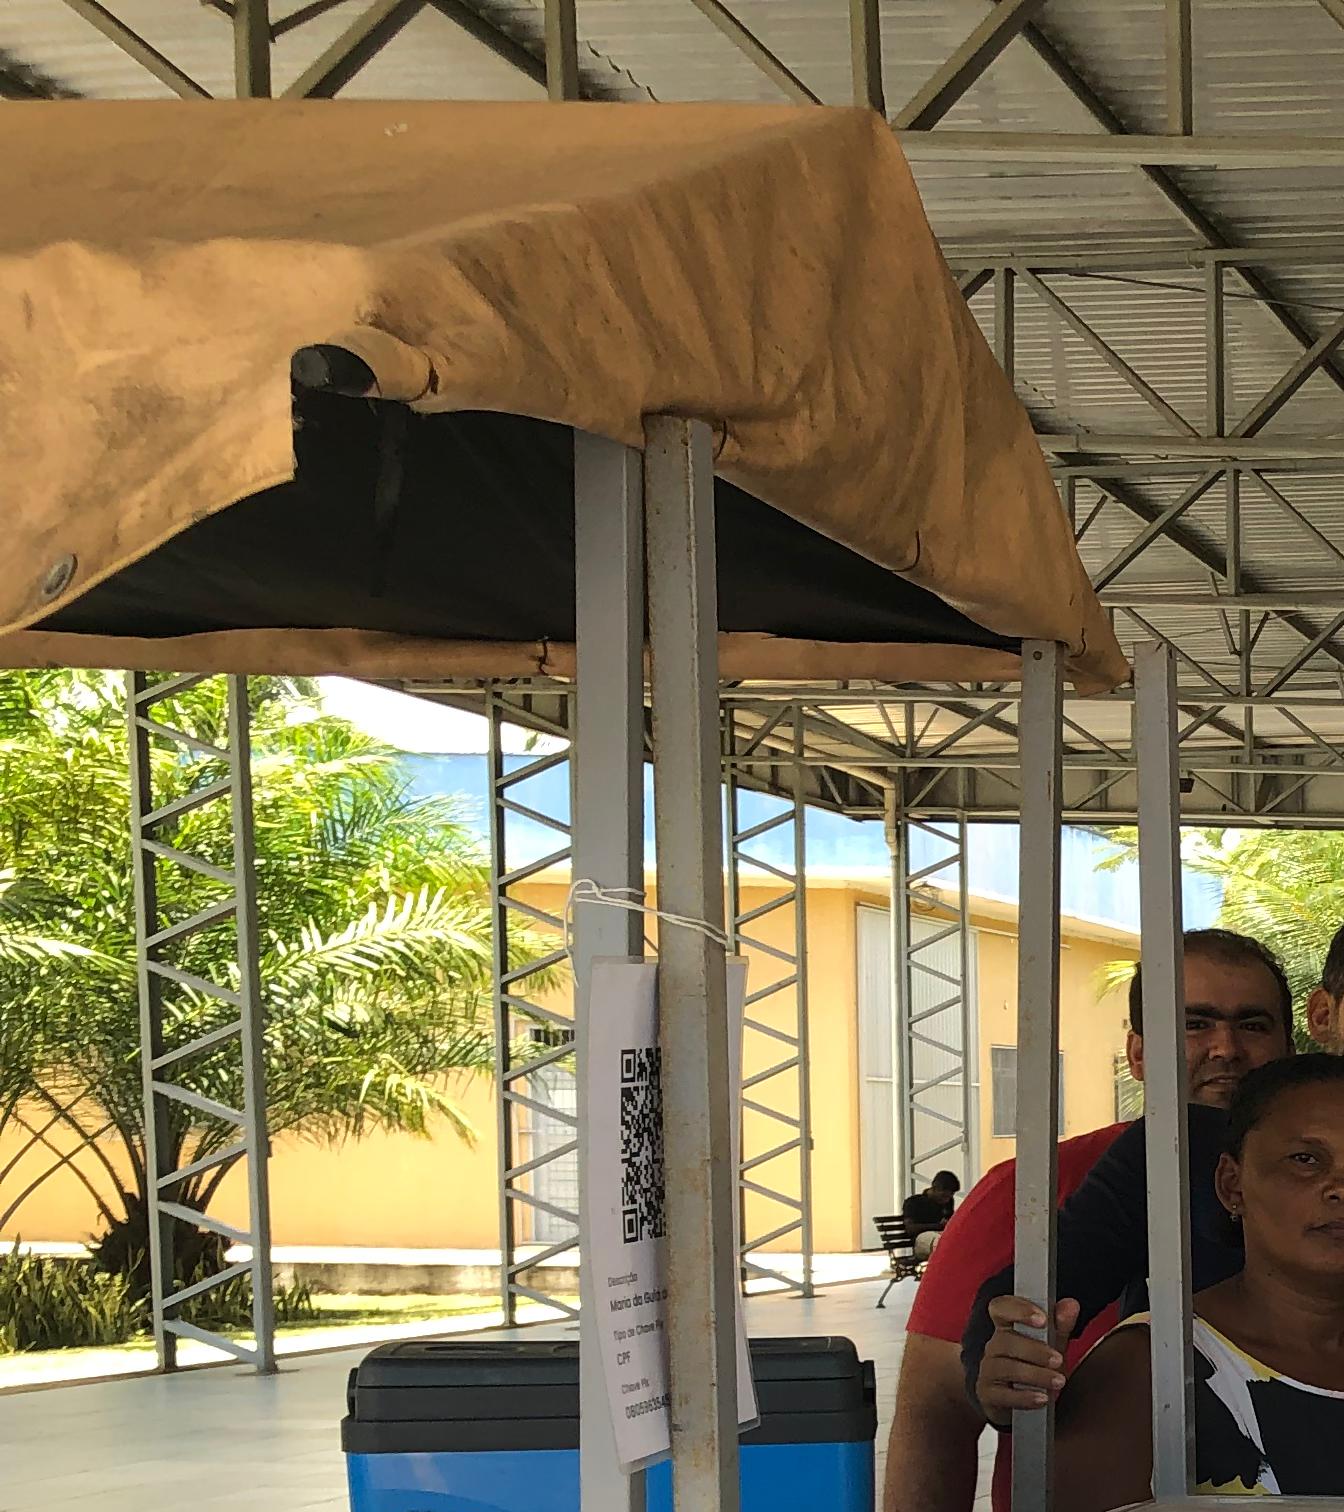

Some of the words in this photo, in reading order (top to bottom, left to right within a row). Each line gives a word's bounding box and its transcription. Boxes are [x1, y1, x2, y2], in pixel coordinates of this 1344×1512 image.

[610, 1296, 631, 1312] Maria
[614, 1330, 626, 1343] Tipo
[636, 1322, 655, 1336] Chave
[617, 1351, 631, 1366] CPF
[622, 1382, 640, 1394] Chave
